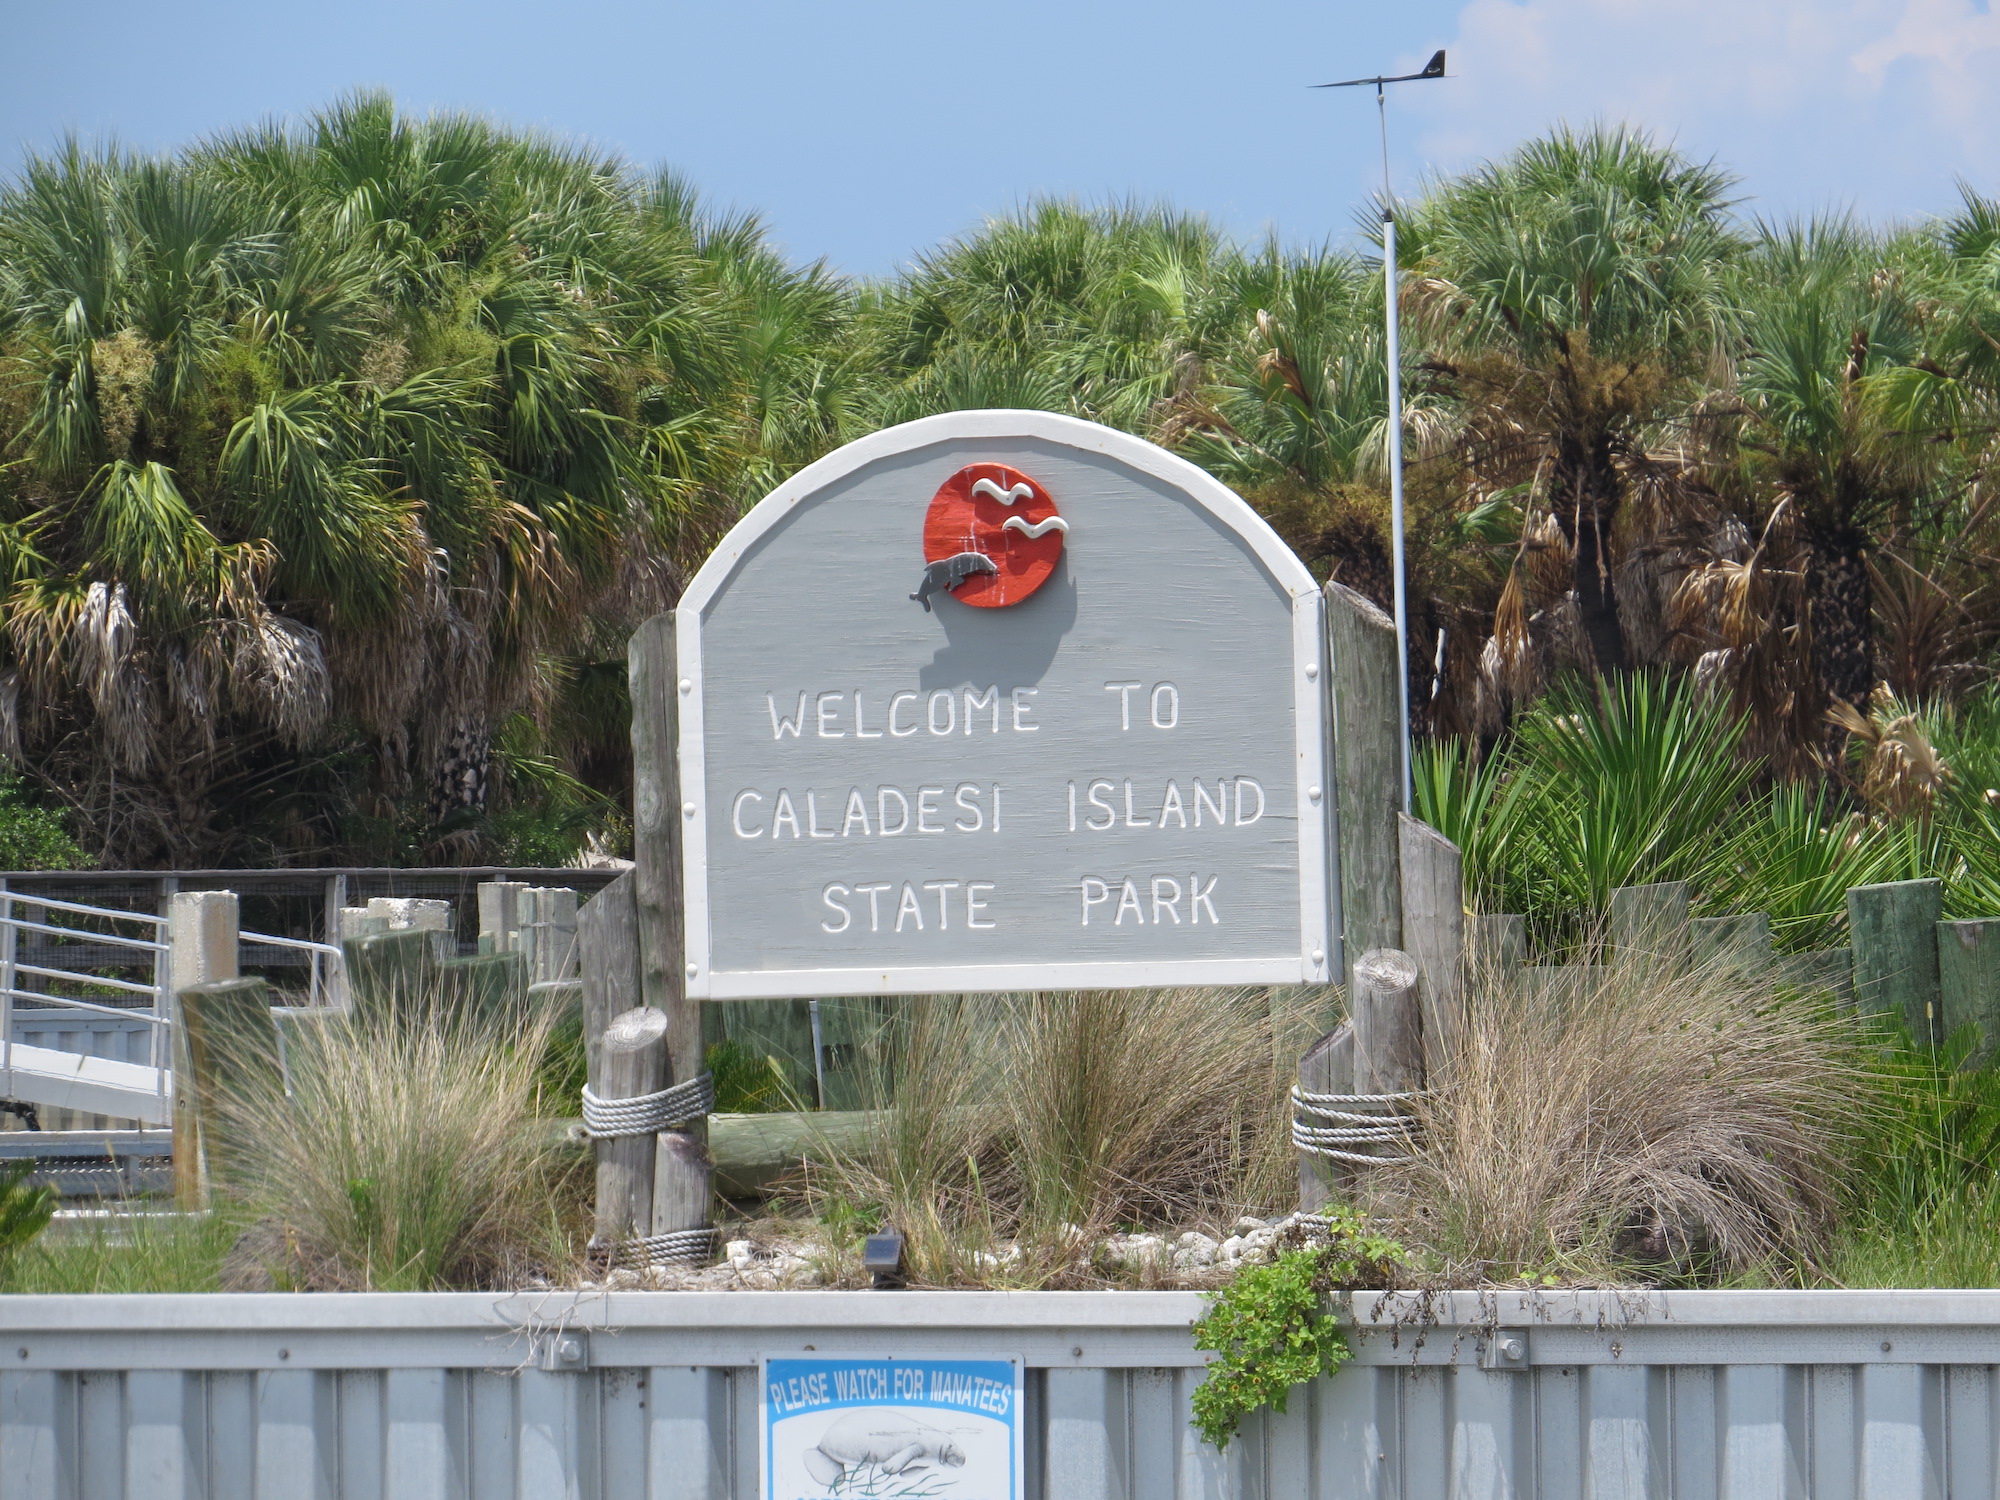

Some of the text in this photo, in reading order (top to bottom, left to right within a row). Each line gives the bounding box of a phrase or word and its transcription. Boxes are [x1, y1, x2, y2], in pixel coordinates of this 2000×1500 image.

[766, 680, 1179, 739] WELCOME TO
[732, 775, 1265, 839] CALADESI ISLAND
[821, 872, 1220, 932] STATE PARK
[770, 1368, 1012, 1415] PLEASE WATCH FOR MANATEES
